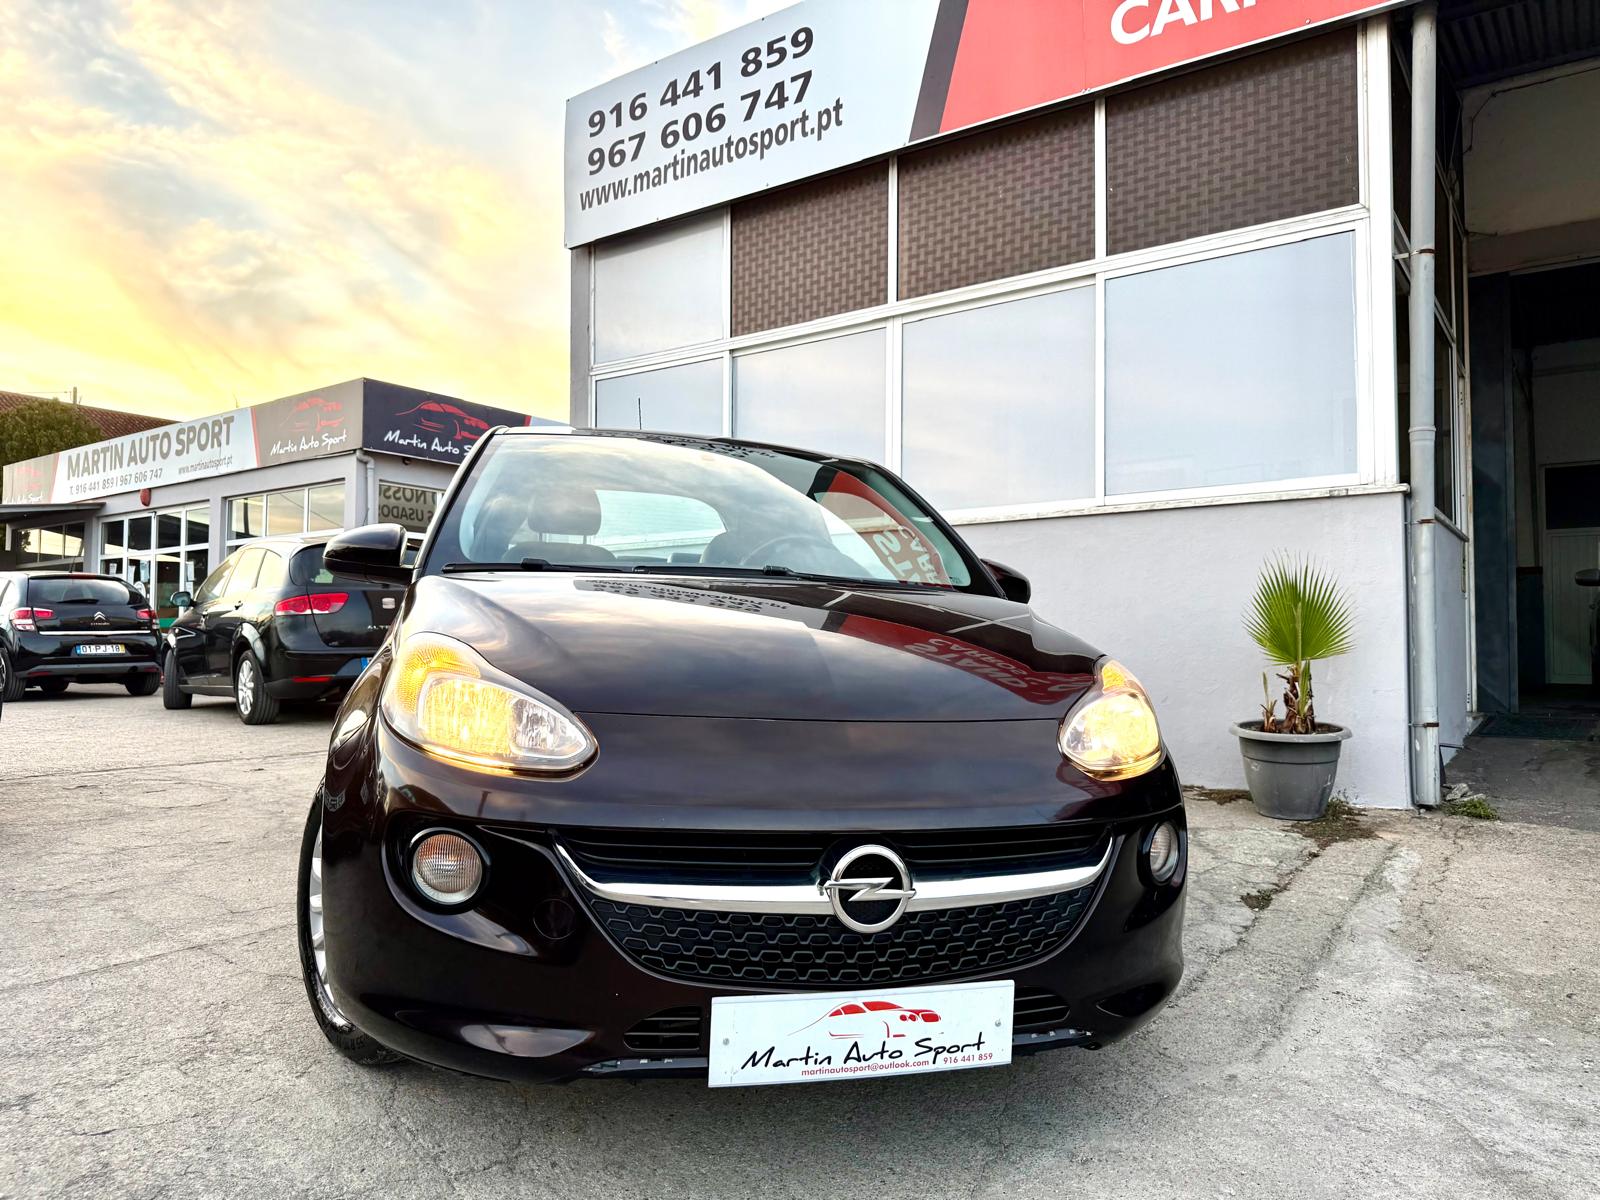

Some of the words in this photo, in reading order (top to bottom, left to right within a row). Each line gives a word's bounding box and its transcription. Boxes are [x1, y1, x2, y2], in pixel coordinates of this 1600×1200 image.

[588, 93, 648, 138] 916
[660, 61, 722, 108] 441
[740, 26, 814, 78] 859
[587, 131, 646, 176] 967
[660, 103, 726, 149] 606
[740, 70, 813, 122] 747
[579, 97, 843, 211] www.martinautosport.pt
[67, 442, 123, 480] MARTIN
[127, 431, 171, 467] AUTO
[175, 415, 234, 457] SPORT
[270, 439, 297, 456] Martin
[300, 435, 319, 451] Auto
[321, 428, 347, 451] Sport
[384, 429, 427, 449] Martin
[431, 437, 460, 455] Auto
[178, 455, 233, 475] www.martinautosport.pt
[75, 482, 87, 494] 916
[88, 480, 100, 493] 441
[101, 477, 114, 490] 859
[119, 474, 132, 486] 967
[134, 471, 148, 484] 606
[149, 468, 163, 480] 747
[740, 1046, 831, 1070] Martin
[843, 1041, 903, 1065] Auto
[914, 1031, 986, 1065] Sport
[943, 1055, 959, 1065] 916
[960, 1054, 976, 1064] 441
[977, 1051, 994, 1062] 859
[801, 1058, 930, 1077] martinautosport@outlook.com
